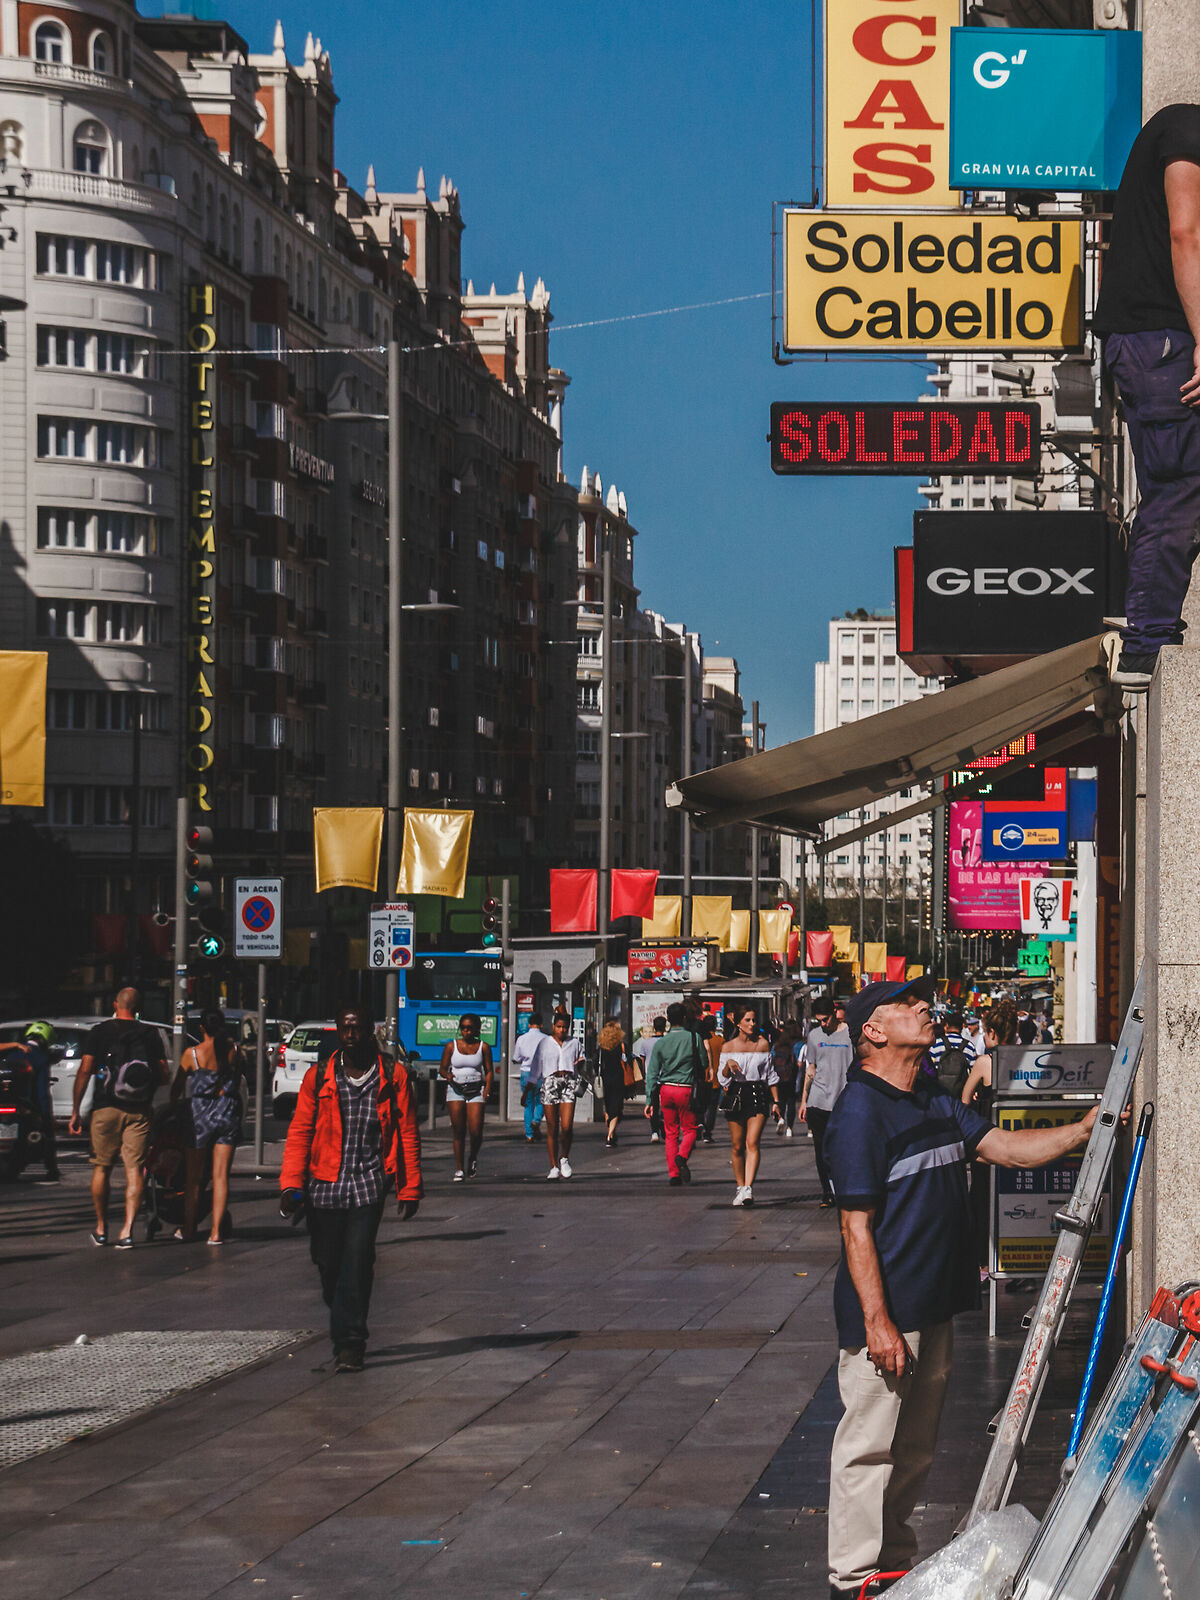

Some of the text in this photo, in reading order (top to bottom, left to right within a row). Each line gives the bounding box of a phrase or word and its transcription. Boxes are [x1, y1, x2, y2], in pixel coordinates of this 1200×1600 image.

[843, 0, 945, 195] CAS
[961, 162, 1097, 178] GRAN VIA CAPITAL
[805, 220, 1062, 275] Soledad
[815, 286, 1054, 340] Cabello
[188, 284, 217, 466] HOTEL
[780, 411, 1031, 463] SOLEDAD
[926, 567, 1095, 596] GEOX
[187, 489, 216, 812] EMPERADOR
[958, 871, 974, 884] DE
[977, 871, 1001, 885] LAS
